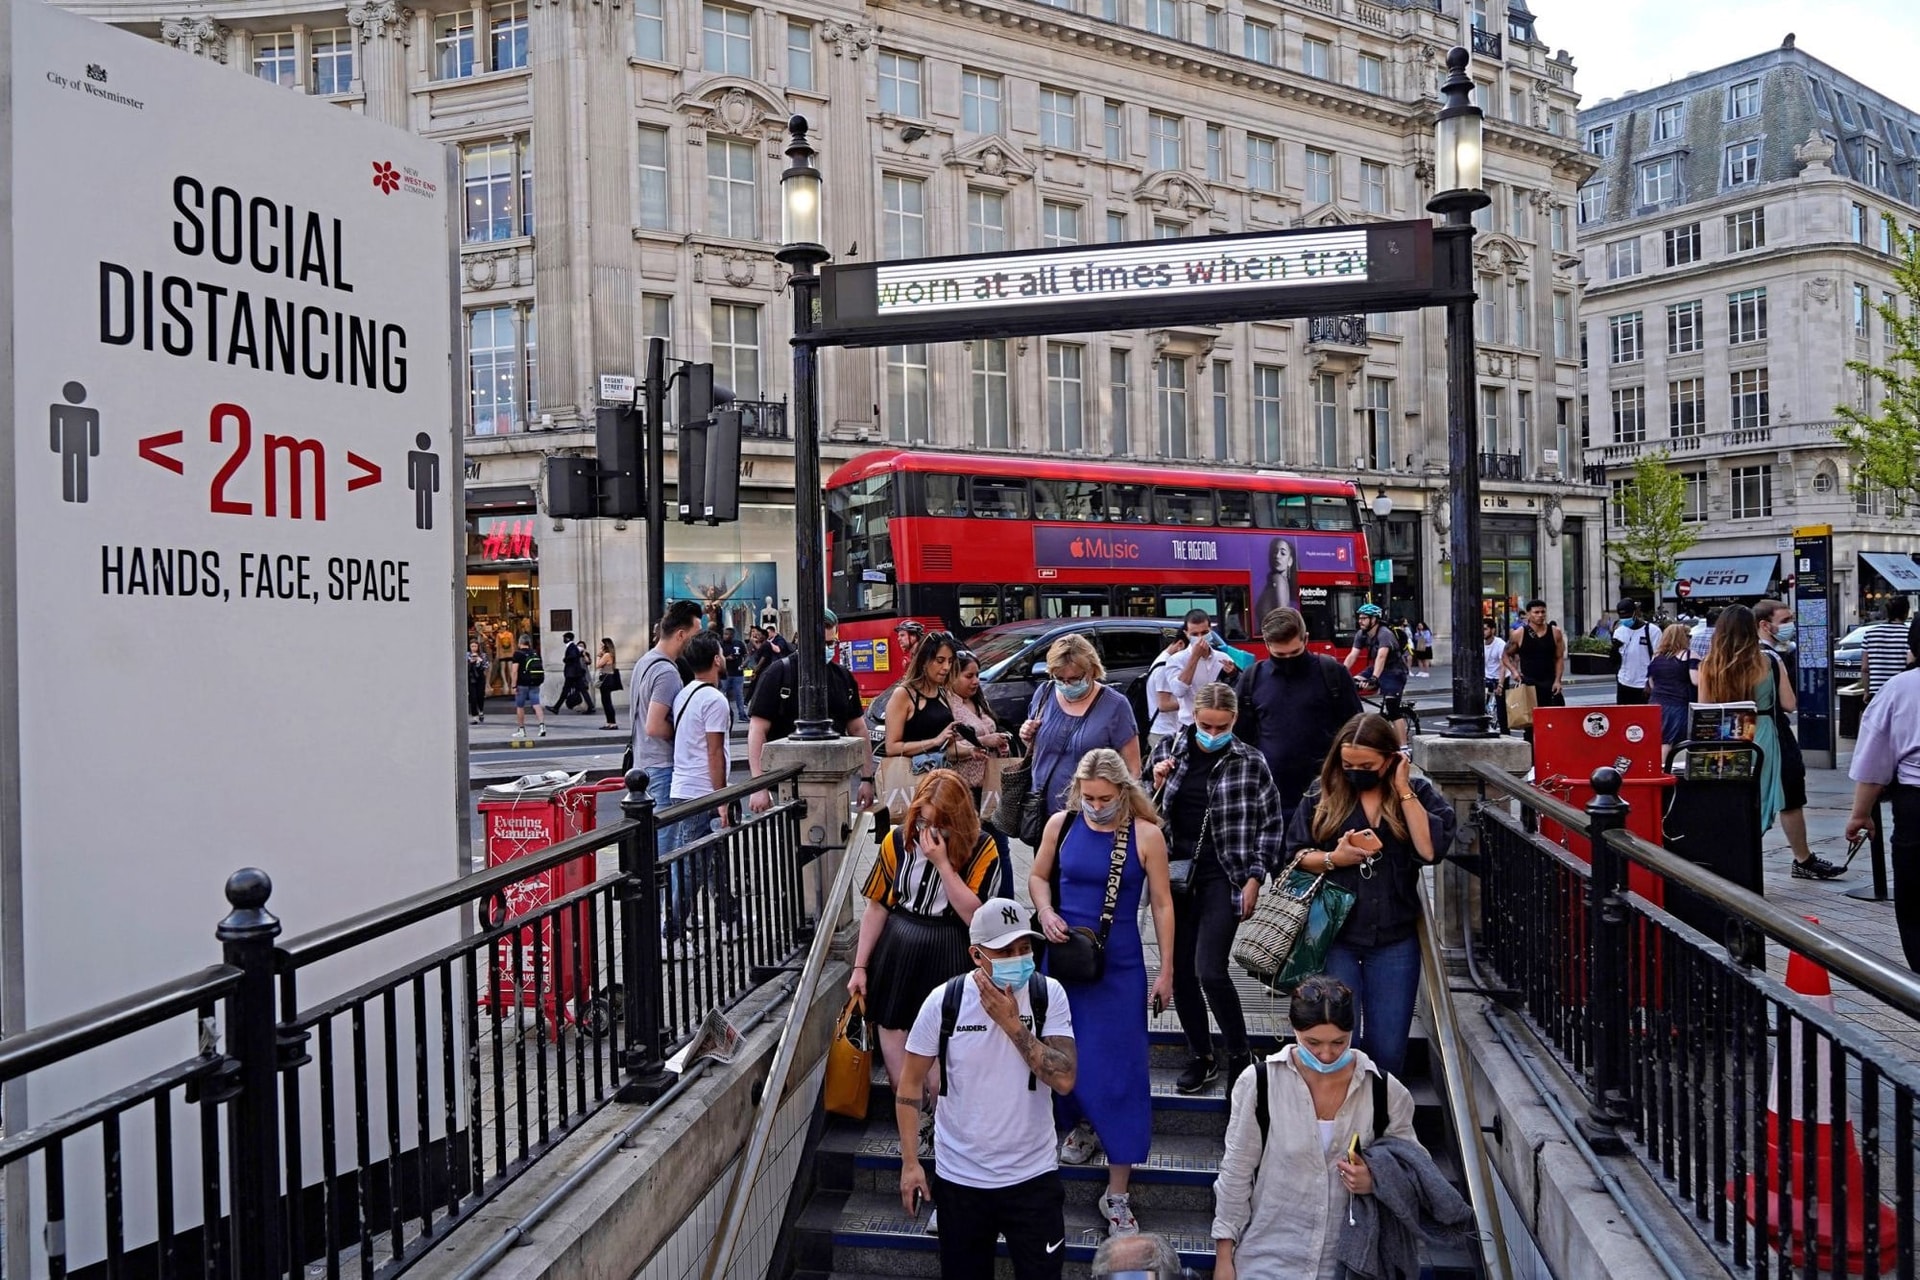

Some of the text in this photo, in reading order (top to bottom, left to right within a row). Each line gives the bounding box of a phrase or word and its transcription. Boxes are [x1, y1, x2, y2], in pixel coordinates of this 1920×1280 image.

[46, 71, 145, 109] City of Westminster
[403, 166, 419, 177] NEW
[403, 184, 434, 199] COMPANY
[404, 176, 437, 192] WEST END
[173, 175, 354, 293] SOCIAL
[877, 280, 960, 305] worn
[974, 272, 1009, 299] at
[1020, 265, 1060, 296] all
[1070, 261, 1173, 292] times
[1185, 254, 1287, 285] when
[100, 261, 408, 394] DISTANCING
[209, 402, 327, 522] 2m
[482, 520, 535, 561] H&M
[1086, 538, 1140, 560] Music
[1172, 541, 1217, 560] THE AGENDA
[102, 545, 410, 603] HANDS, FACE, SPACE
[1688, 574, 1750, 586] NERO
[494, 816, 543, 829] Evening
[493, 827, 549, 839] Standard
[956, 1025, 988, 1033] RAIDERS
